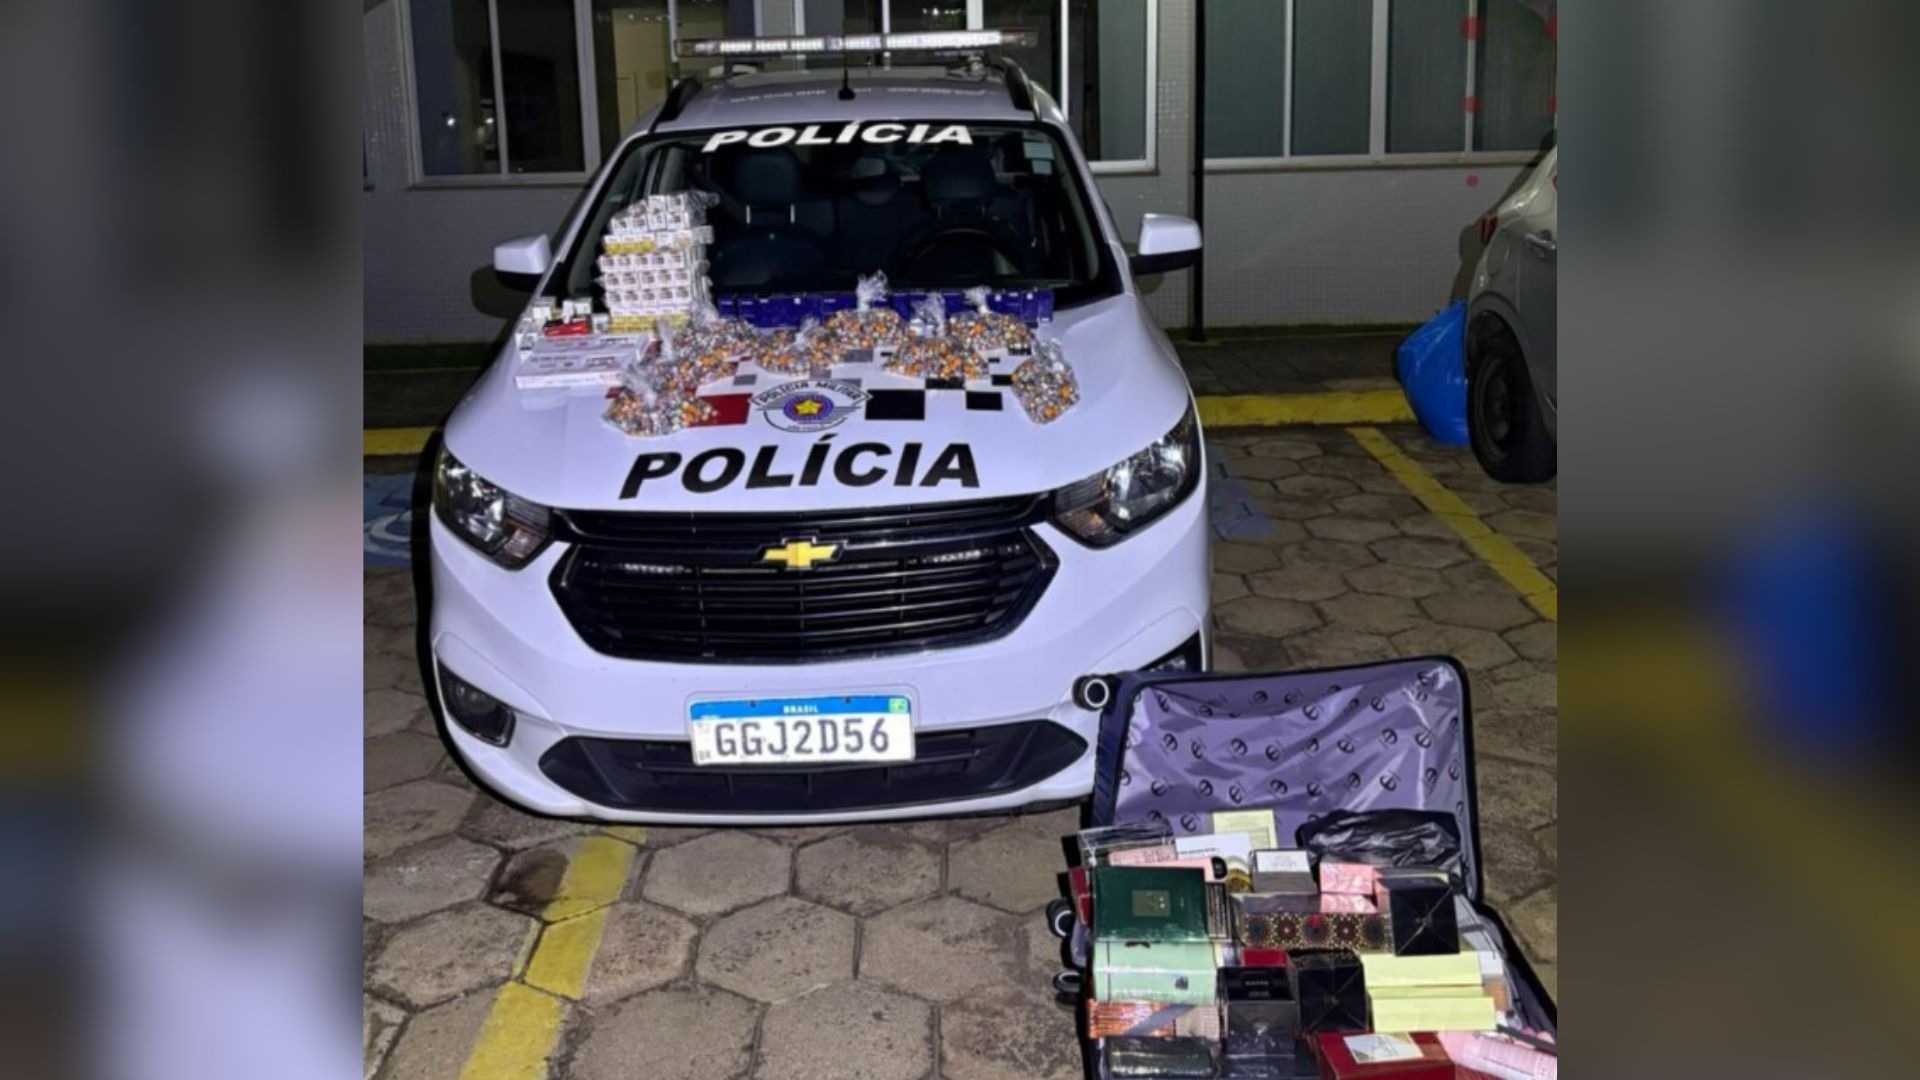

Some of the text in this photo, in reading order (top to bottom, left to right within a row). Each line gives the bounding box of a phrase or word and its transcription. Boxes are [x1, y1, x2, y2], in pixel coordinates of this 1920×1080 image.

[702, 119, 973, 153] POLÍCIA
[618, 433, 980, 500] POLÍCIA
[783, 704, 819, 714] BRASIL
[715, 717, 889, 757] GGJ2D56
